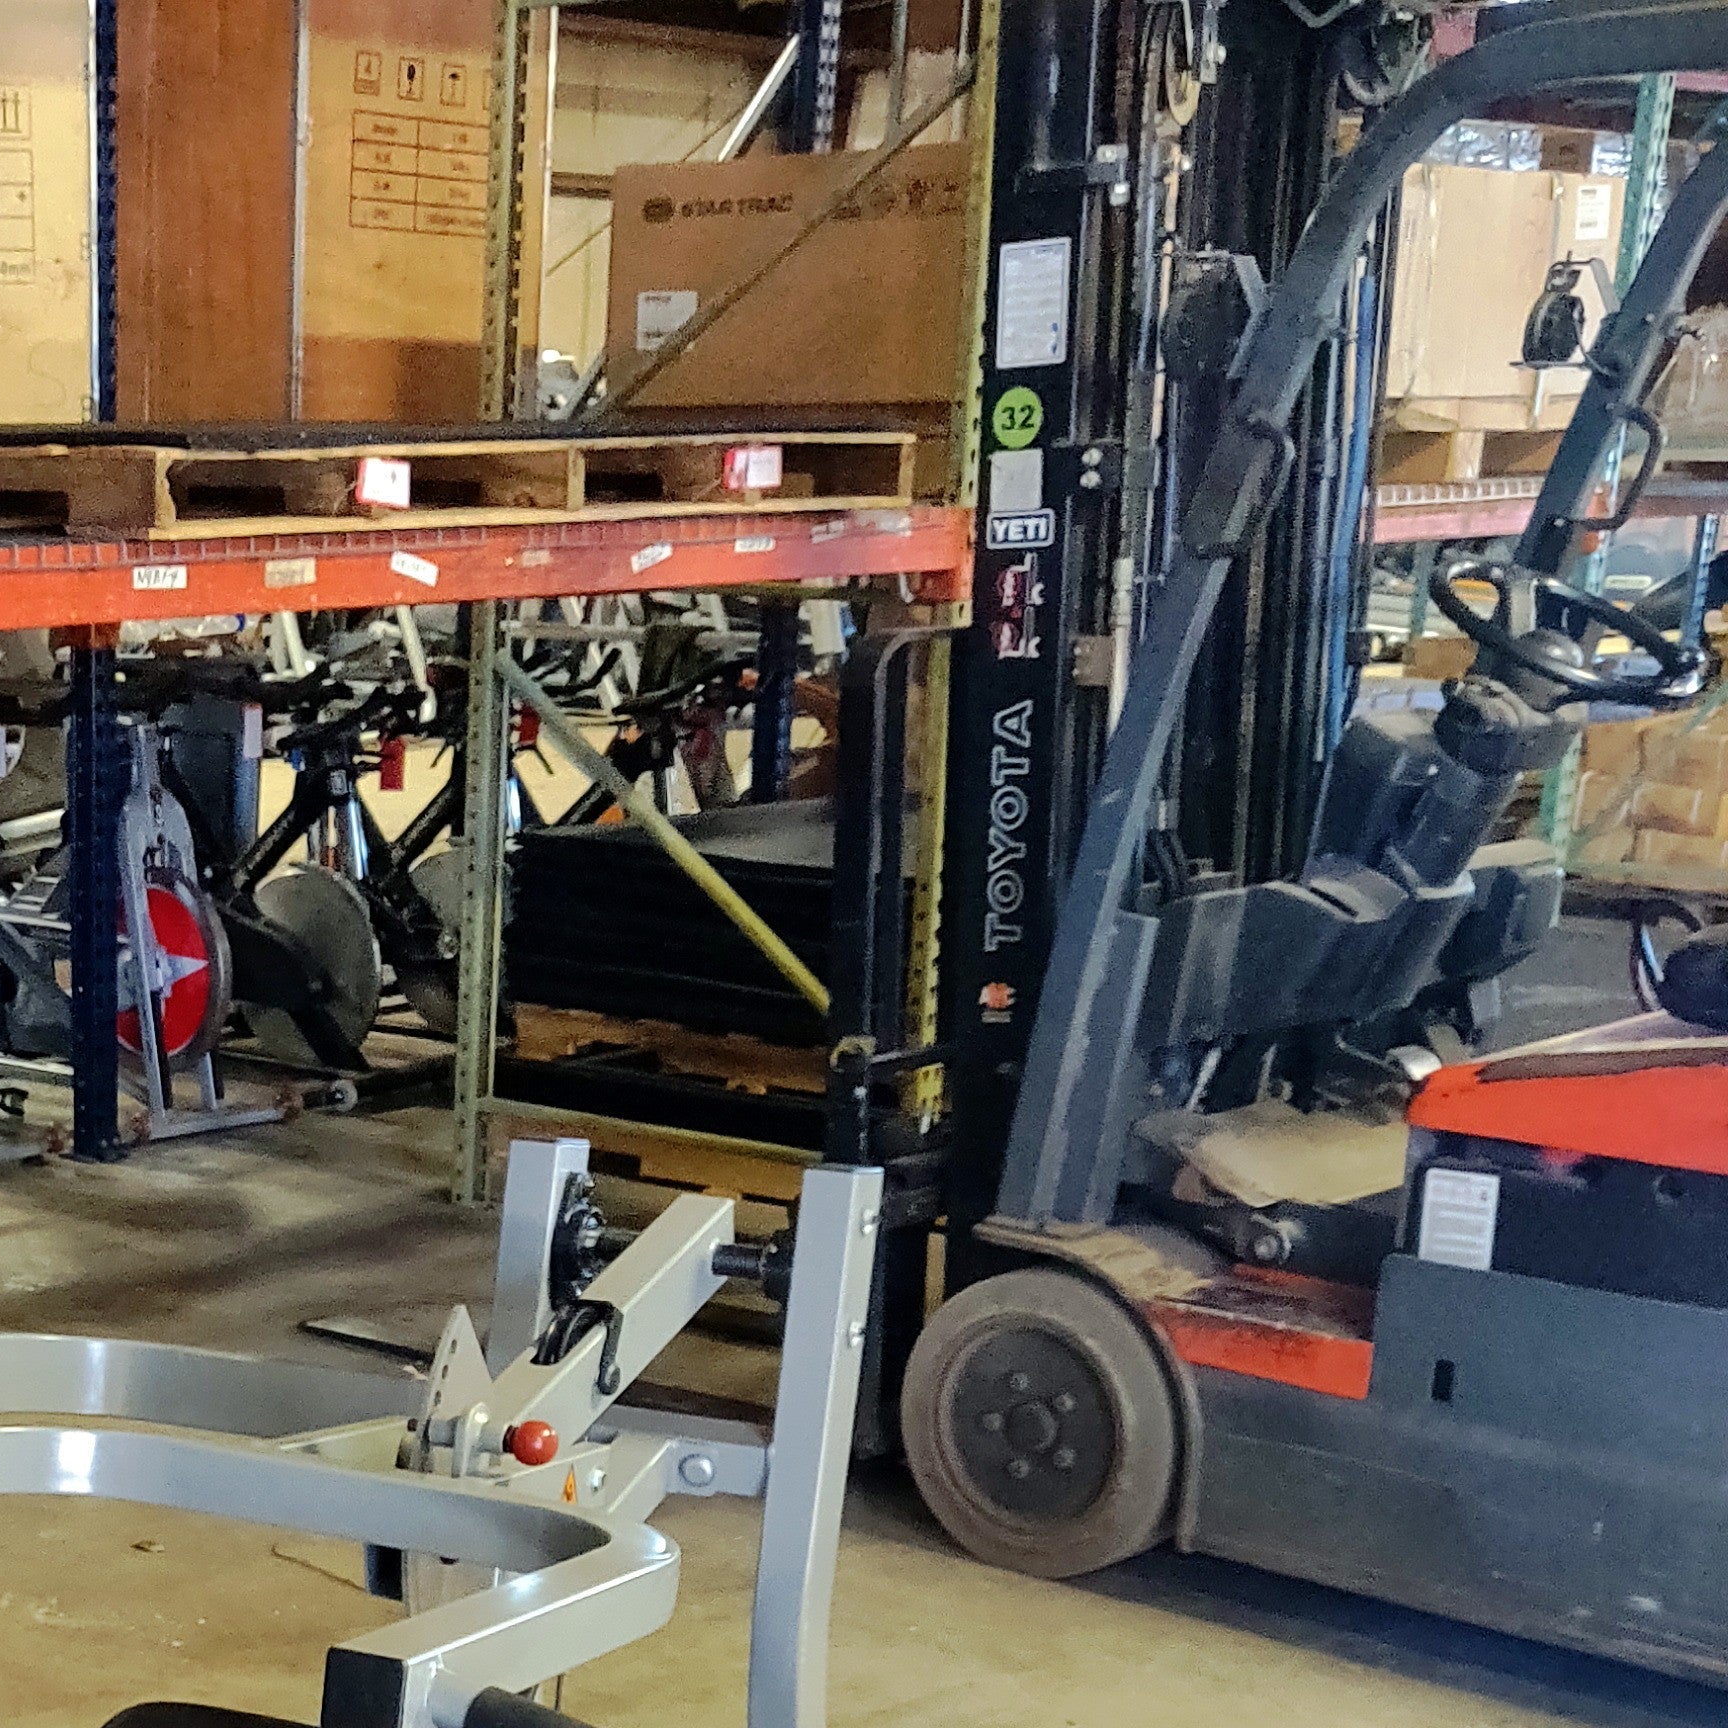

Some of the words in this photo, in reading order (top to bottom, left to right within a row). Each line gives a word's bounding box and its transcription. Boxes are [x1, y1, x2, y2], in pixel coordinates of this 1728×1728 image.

[1000, 404, 1036, 431] 32
[992, 518, 1048, 543] YETI
[983, 699, 1034, 952] TOYOTA
